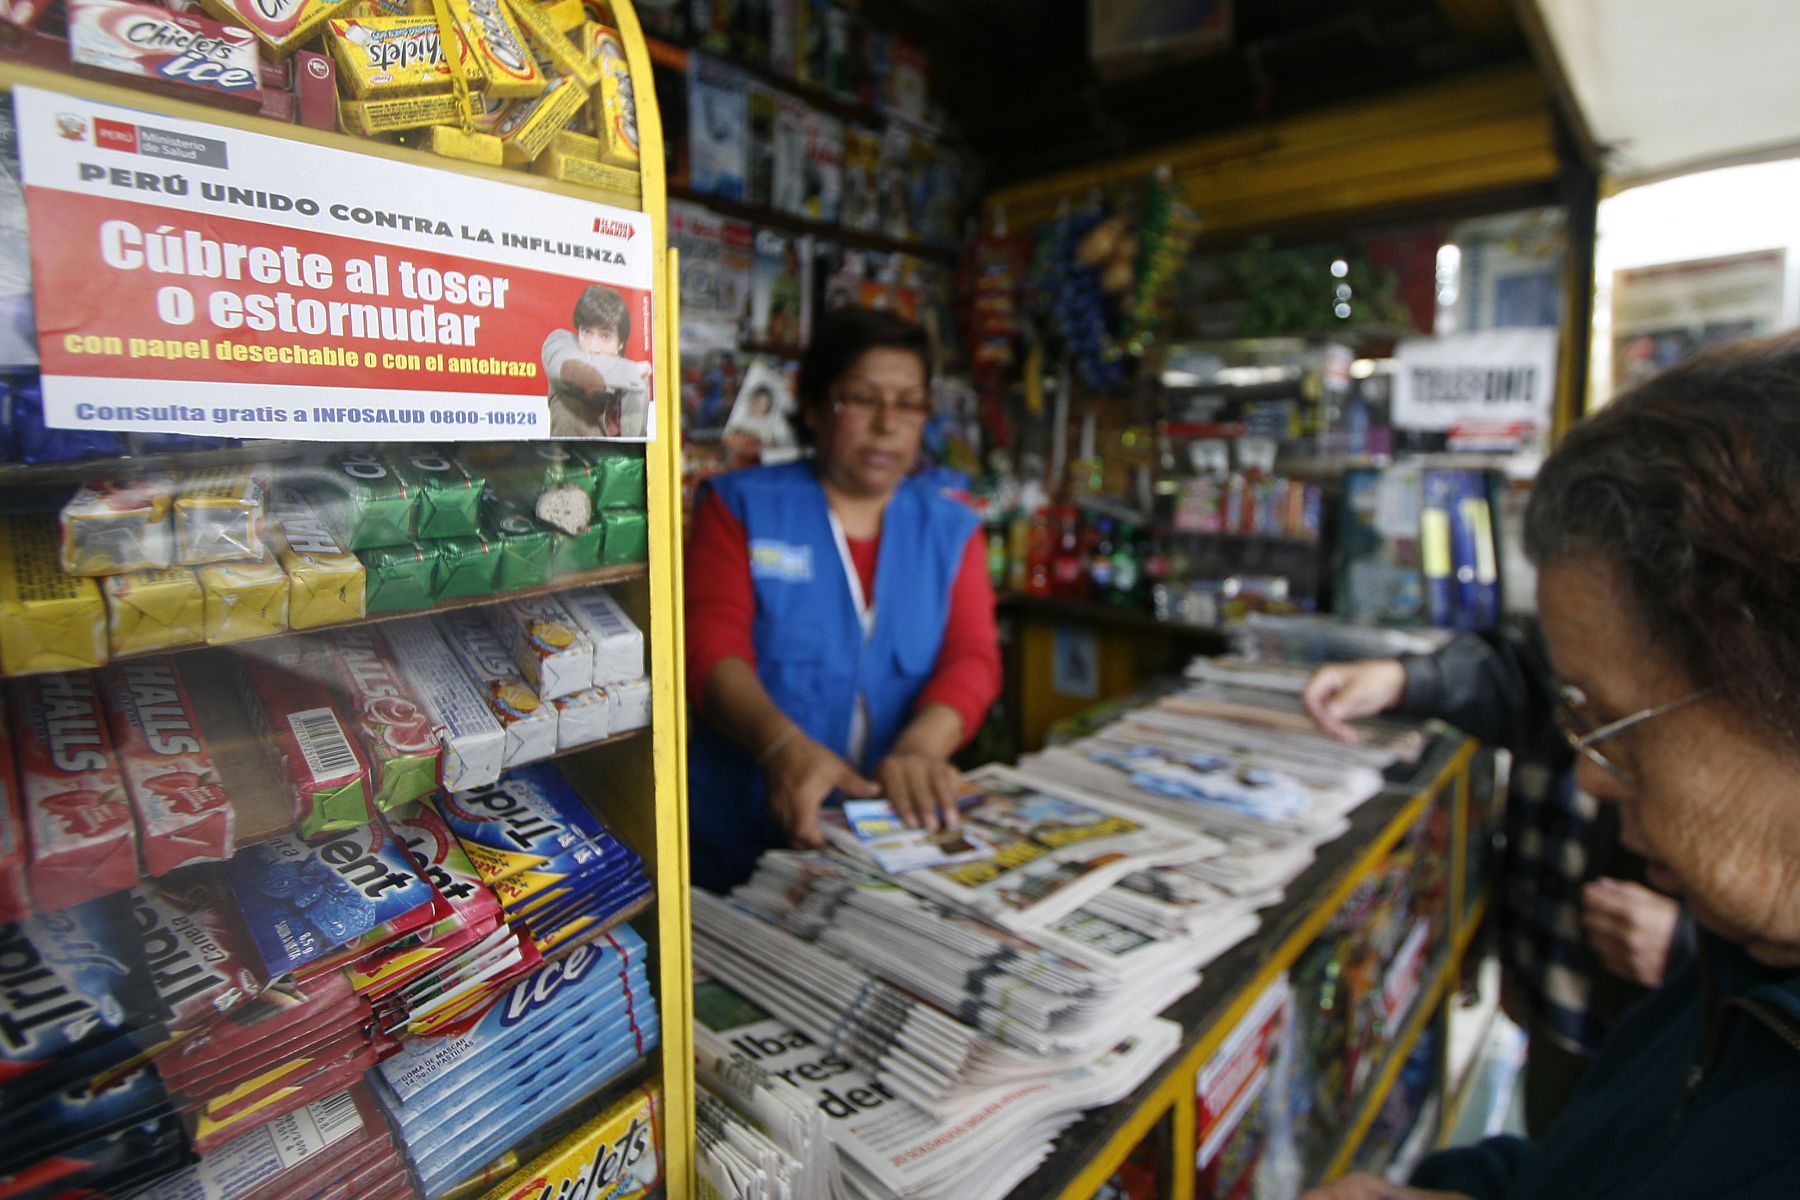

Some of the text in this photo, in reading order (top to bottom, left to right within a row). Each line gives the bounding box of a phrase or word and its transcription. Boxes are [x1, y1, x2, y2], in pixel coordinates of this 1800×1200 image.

[127, 22, 236, 60] Chiclets
[368, 35, 446, 71] hiclets
[159, 51, 255, 89] ice
[141, 131, 206, 151] Ministerio
[142, 143, 197, 159] de Salud
[79, 162, 627, 266] PERÚ UNIDO CONTRA LA INFLUENZA
[100, 219, 510, 310] Cúbrete al toser
[156, 285, 481, 347] o estornudar
[63, 334, 538, 379] con papel desechable o con el antebrazo
[75, 402, 538, 426] Consulta gratis a INFOSALUD 0800-10828
[123, 666, 201, 756] HALLS
[172, 915, 226, 962] Canela
[400, 1063, 424, 1082] GOMA
[435, 1036, 466, 1060] MASCAR
[436, 1038, 474, 1066] PASTILLAS
